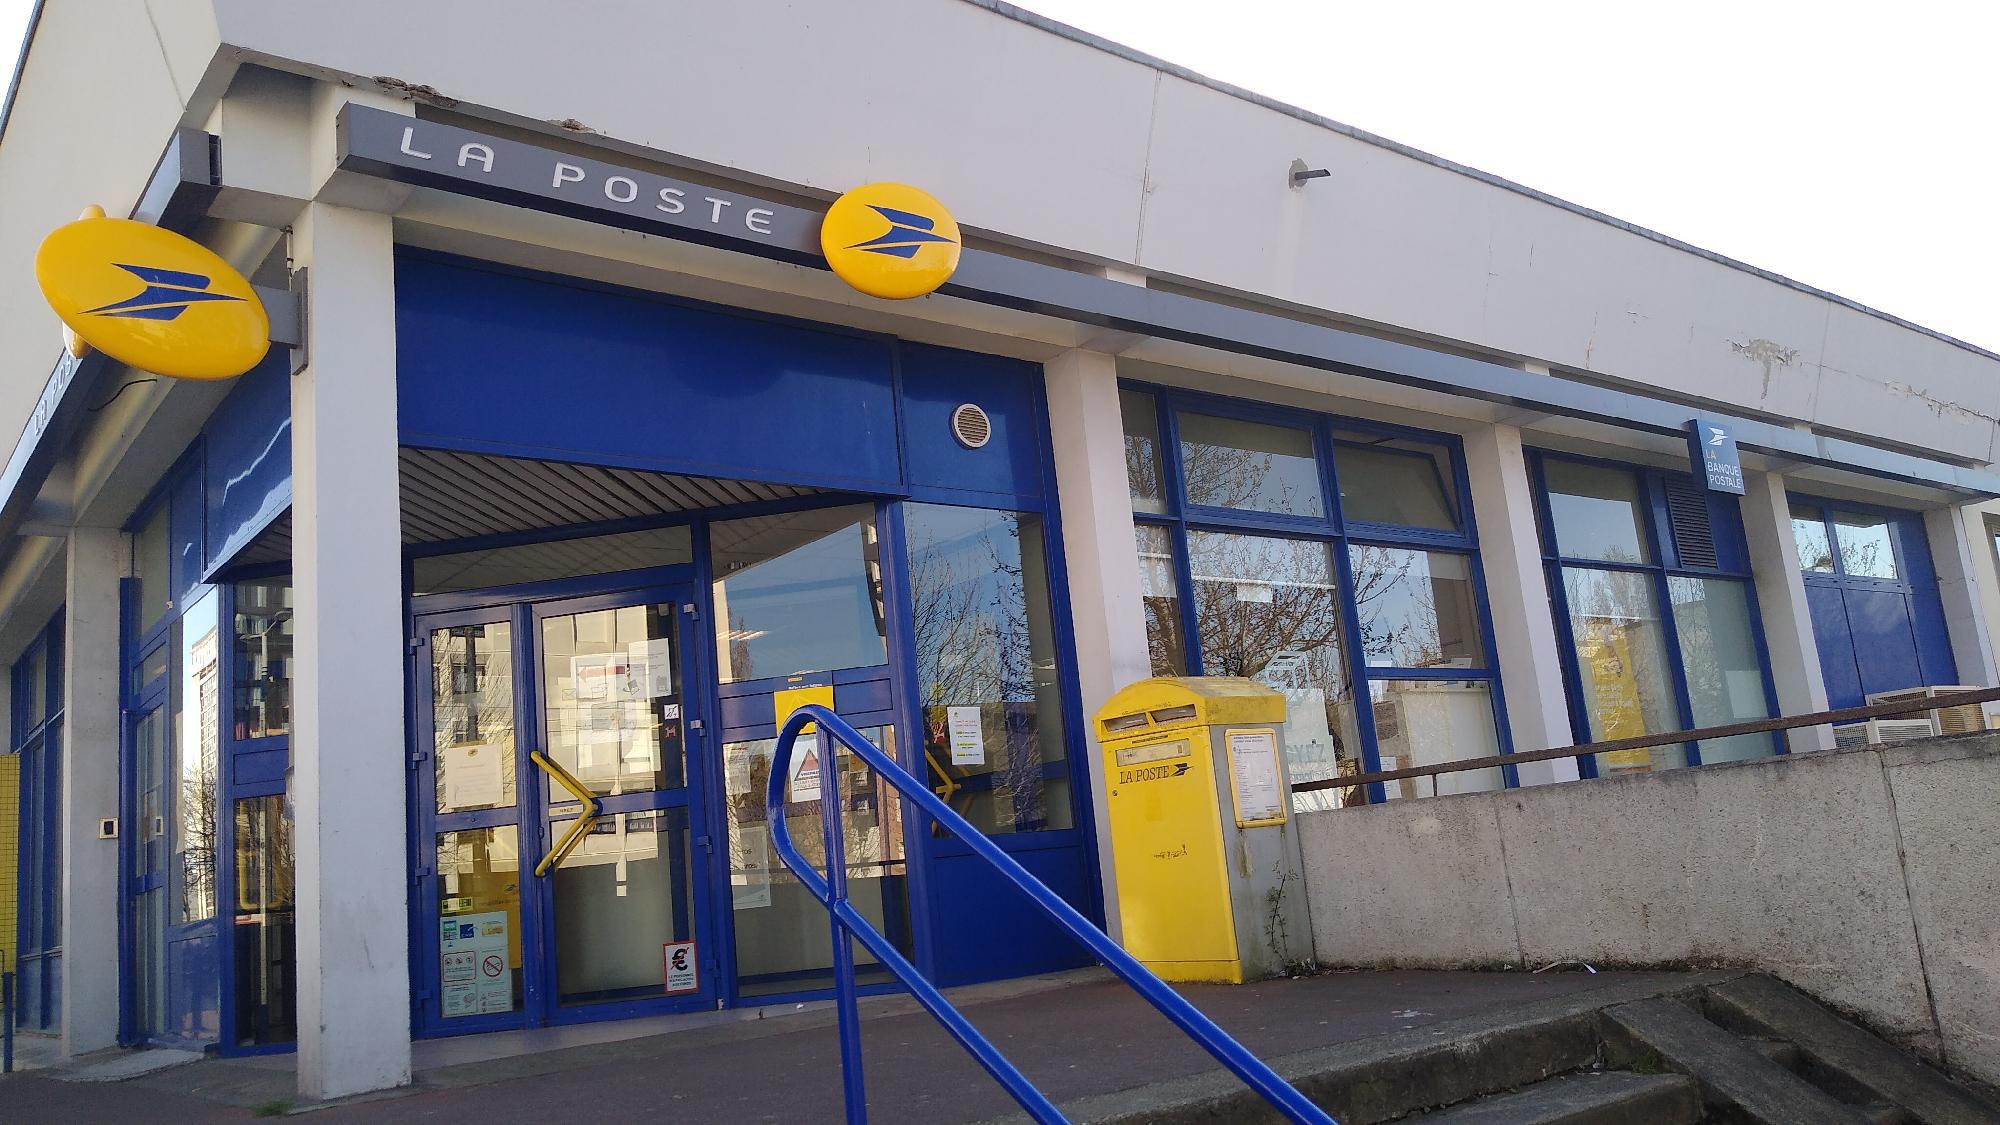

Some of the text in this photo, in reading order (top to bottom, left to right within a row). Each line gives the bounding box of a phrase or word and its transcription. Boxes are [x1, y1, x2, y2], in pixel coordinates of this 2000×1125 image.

[400, 127, 774, 234] LA POSTE
[34, 353, 72, 436] LA POS
[1706, 450, 1716, 459] LA
[1708, 462, 1739, 476] BANQUE
[1710, 475, 1741, 488] POSTALE
[1119, 764, 1170, 785] LA POSTE
